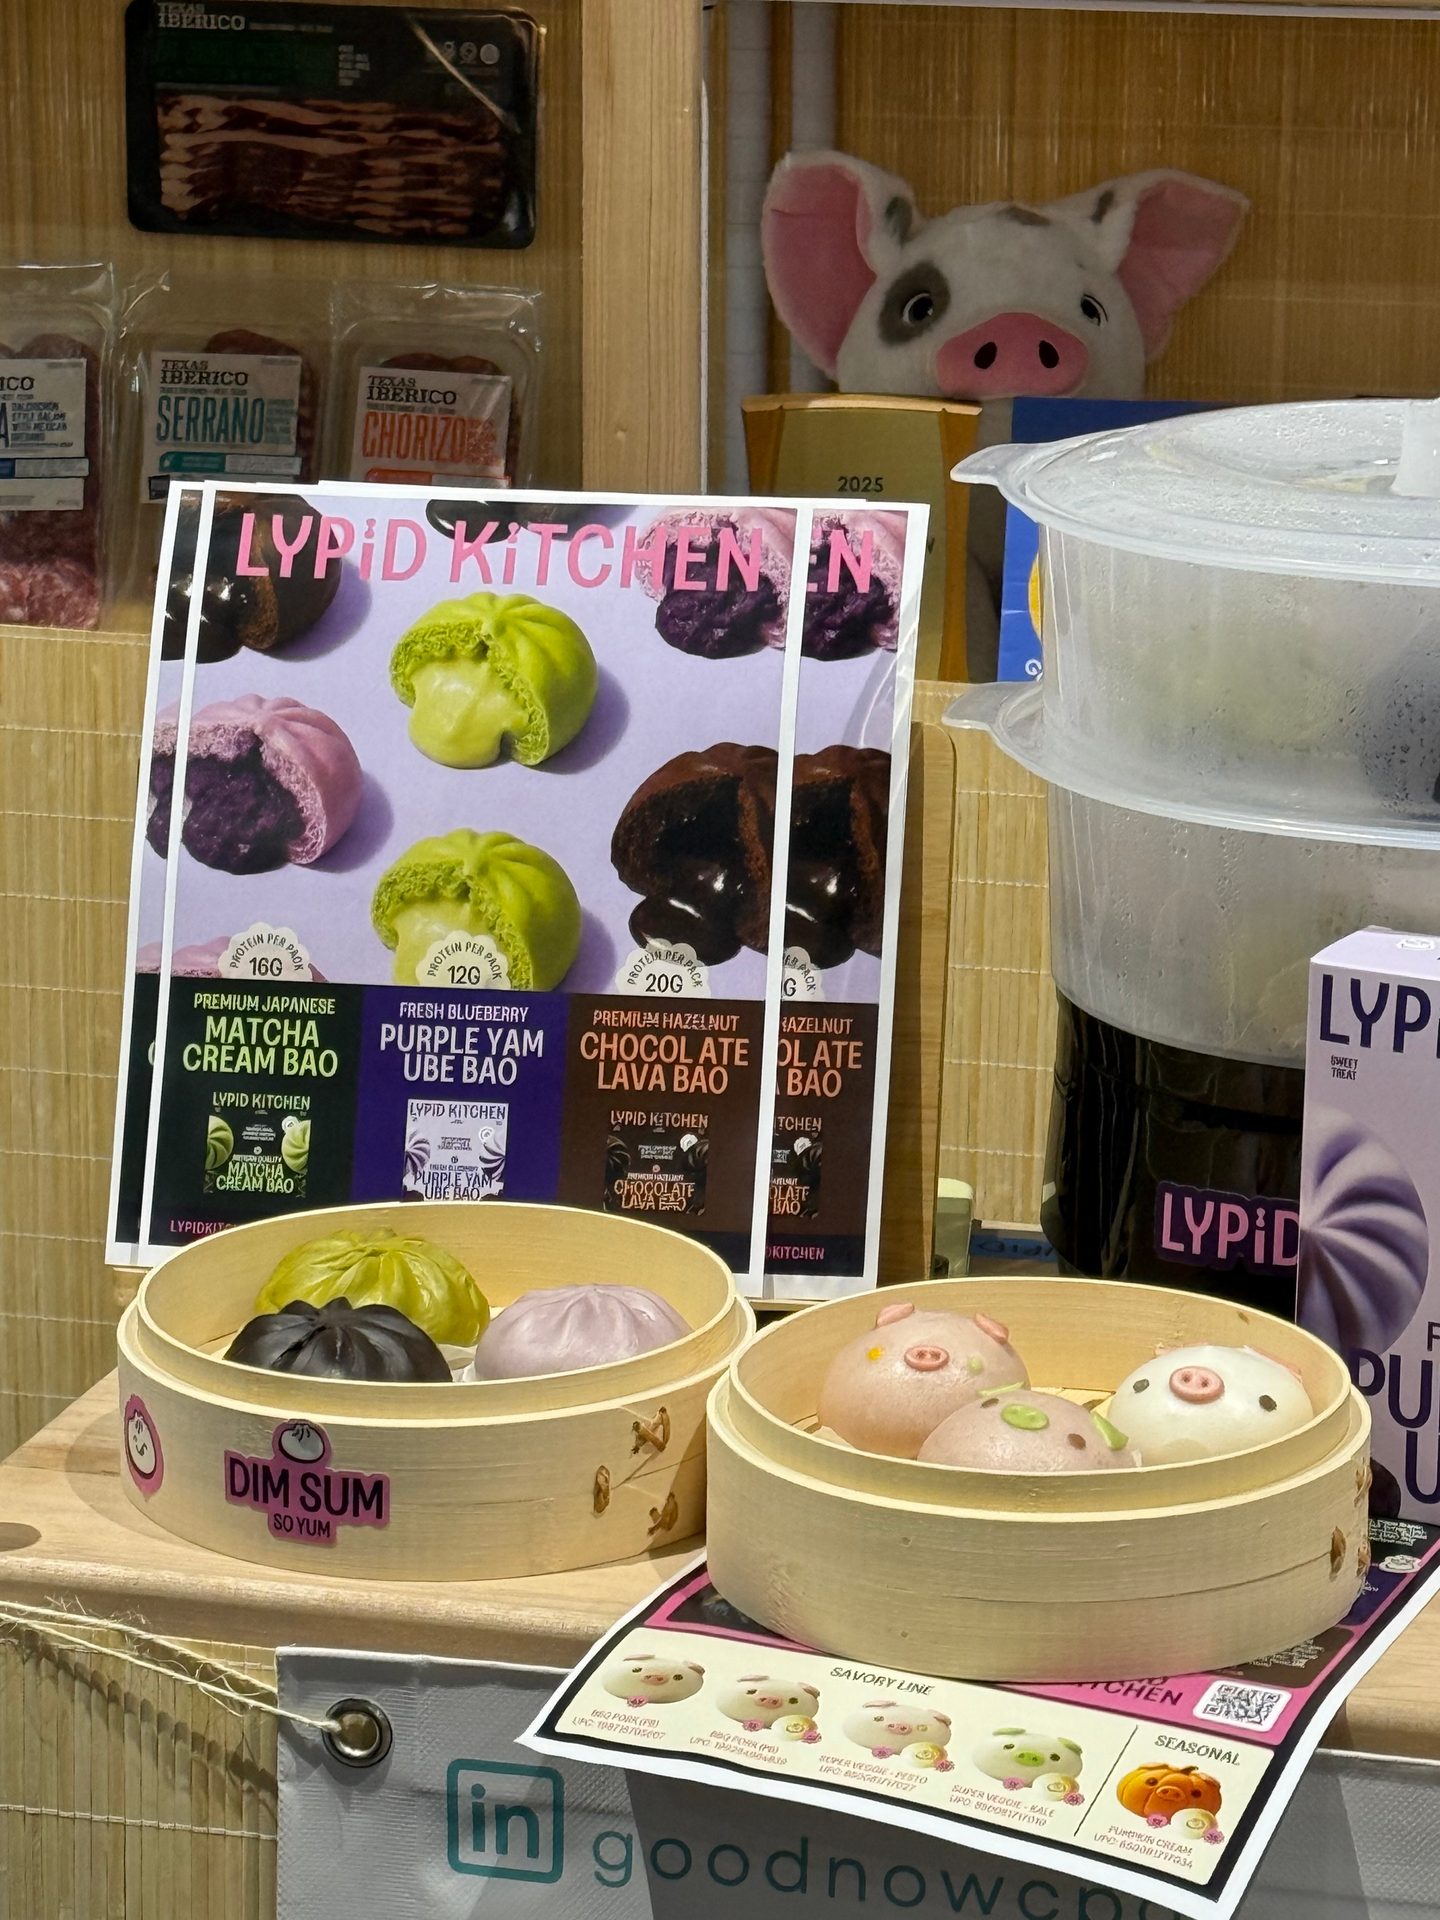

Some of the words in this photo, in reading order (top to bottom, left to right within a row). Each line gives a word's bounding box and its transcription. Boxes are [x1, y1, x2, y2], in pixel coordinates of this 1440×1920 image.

[158, 14, 246, 31] IBERICO
[162, 359, 208, 371] TEXAS
[160, 370, 249, 386] IBERICO
[367, 375, 416, 387] TEXAS
[366, 386, 457, 405] IBERICO
[156, 395, 265, 443] SERRANO
[362, 411, 466, 463] CHORIZO
[836, 476, 885, 493] 2025
[229, 933, 264, 969] PROTEIN
[267, 933, 287, 948] PER
[285, 943, 304, 972] PACK
[426, 941, 463, 977] PROTEIN
[465, 941, 485, 957] PER
[484, 953, 503, 980] PACK
[249, 957, 283, 977] 16G
[447, 965, 481, 985] 12G
[627, 950, 662, 985] PROTEIN
[665, 950, 685, 964] PER
[684, 959, 703, 988] PACK
[645, 973, 683, 993] 20G
[193, 993, 260, 1011] PREMIUM
[261, 996, 336, 1015] JAPANESE
[399, 1001, 445, 1020] FRESH
[447, 1003, 530, 1022] BLUEBERRY
[592, 1009, 660, 1028] PREMIUM
[662, 1012, 740, 1032] HAZELNUT
[1320, 973, 1440, 1059] LYP
[204, 1015, 320, 1048] MATCHA
[379, 1023, 480, 1055] PURPLE
[486, 1027, 545, 1058] YAM
[579, 1031, 750, 1067] CHOCOLATE
[182, 1043, 276, 1075] CREAM
[282, 1048, 339, 1078] BAO
[403, 1052, 456, 1083] UBE
[462, 1055, 518, 1086] BAO
[1330, 1055, 1359, 1070] SWEET
[597, 1061, 667, 1093] LAVA
[673, 1065, 729, 1095] BAO
[787, 1068, 842, 1098] BAO
[1331, 1067, 1357, 1081] TREAT
[212, 1091, 249, 1108] LYPID
[252, 1093, 311, 1111] KITCHEN
[409, 1102, 445, 1118] LYPID
[448, 1103, 506, 1120] KITCHEN
[610, 1110, 647, 1126] LYPID
[649, 1112, 709, 1129] KITCHEN
[227, 1161, 285, 1180] MATCHA
[413, 1170, 462, 1189] PURPLE
[466, 1171, 493, 1189] YAM
[216, 1174, 263, 1192] CREAM
[265, 1178, 295, 1194] BAO
[424, 1183, 450, 1200] UBE
[452, 1186, 481, 1201] BAO
[613, 1179, 696, 1198] CHOCOLATE
[229, 1456, 290, 1509] DIM
[299, 1472, 384, 1520] SUM
[272, 1513, 293, 1533] SO
[296, 1516, 331, 1538] YUM
[829, 1666, 896, 1691] SAVORY
[896, 1680, 936, 1696] LINE
[611, 1712, 640, 1726] PORK
[1154, 1734, 1241, 1766] SEASONAL
[470, 1783, 541, 1859] in
[1156, 1835, 1193, 1856] CREAM
